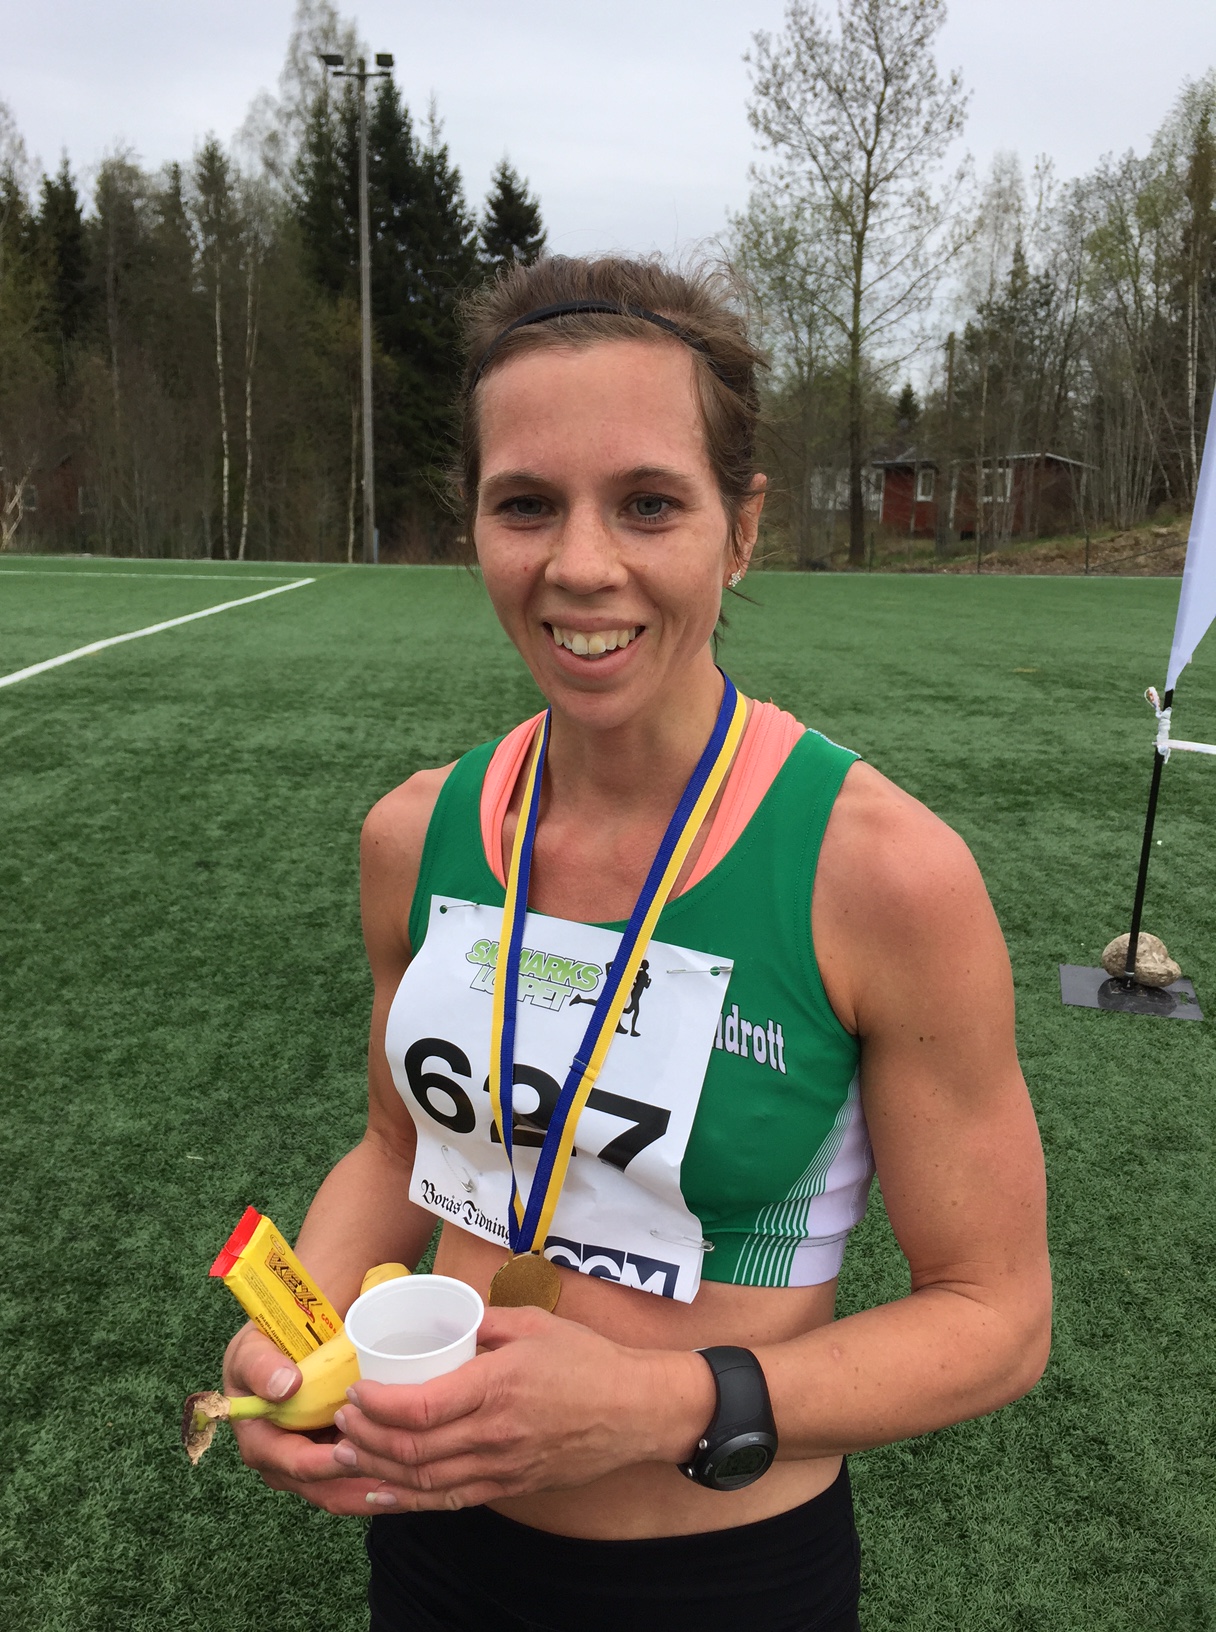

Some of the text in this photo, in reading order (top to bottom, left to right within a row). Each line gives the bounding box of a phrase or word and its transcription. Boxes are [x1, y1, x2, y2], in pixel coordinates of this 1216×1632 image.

[404, 1037, 671, 1173] 627
[421, 1179, 462, 1215] Borås
[268, 1252, 317, 1310] KEX
